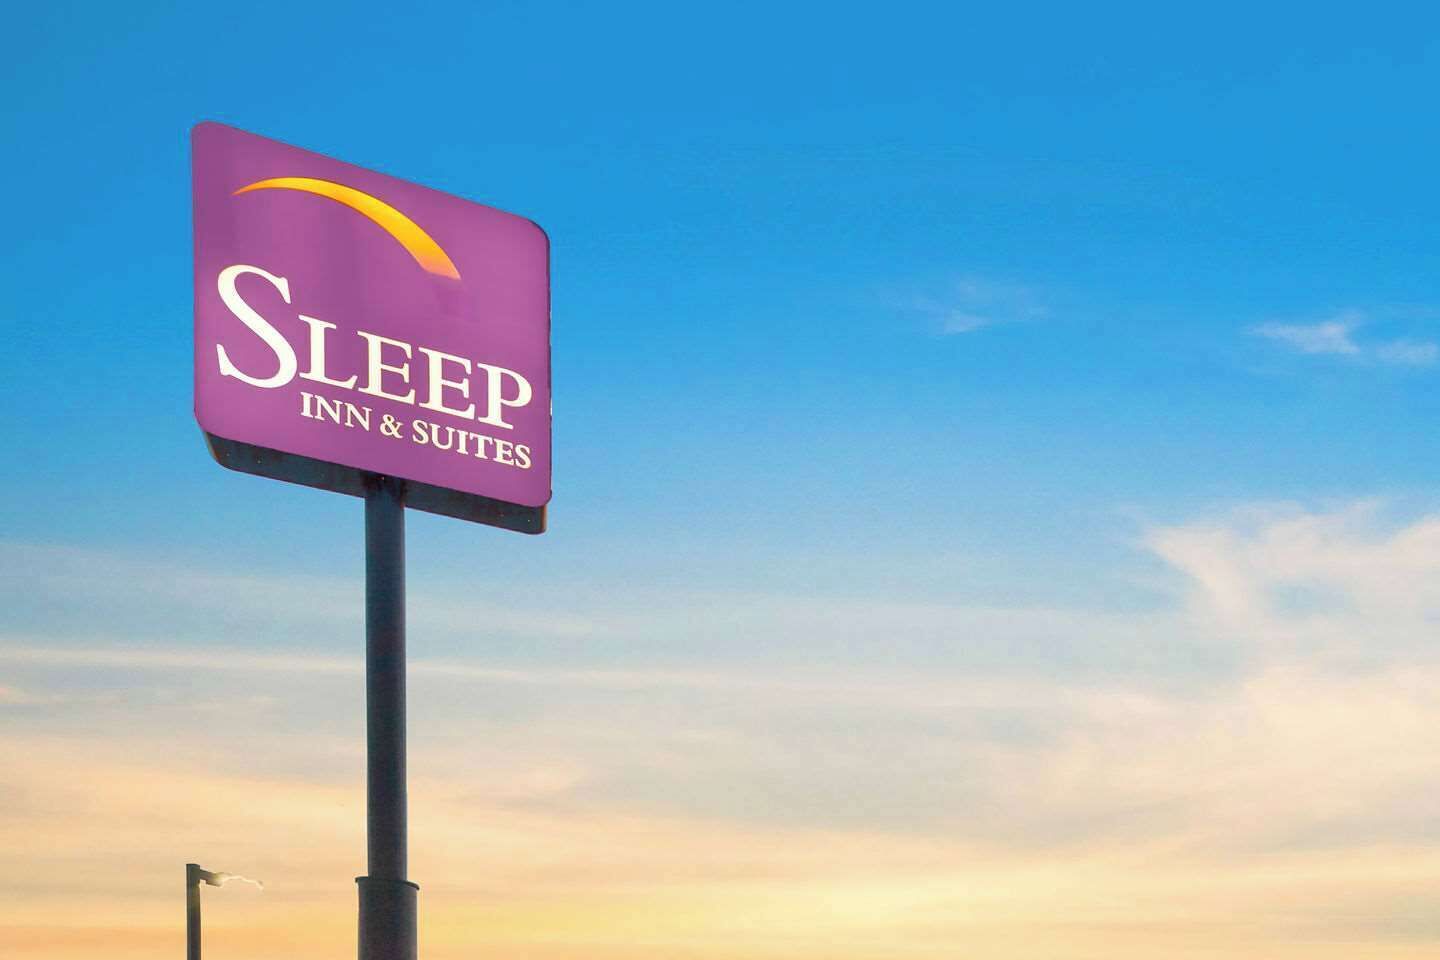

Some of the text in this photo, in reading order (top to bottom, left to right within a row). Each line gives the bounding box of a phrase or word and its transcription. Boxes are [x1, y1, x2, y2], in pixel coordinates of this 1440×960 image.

[216, 264, 533, 430] SLEEP
[300, 391, 532, 470] INN & SUITES
